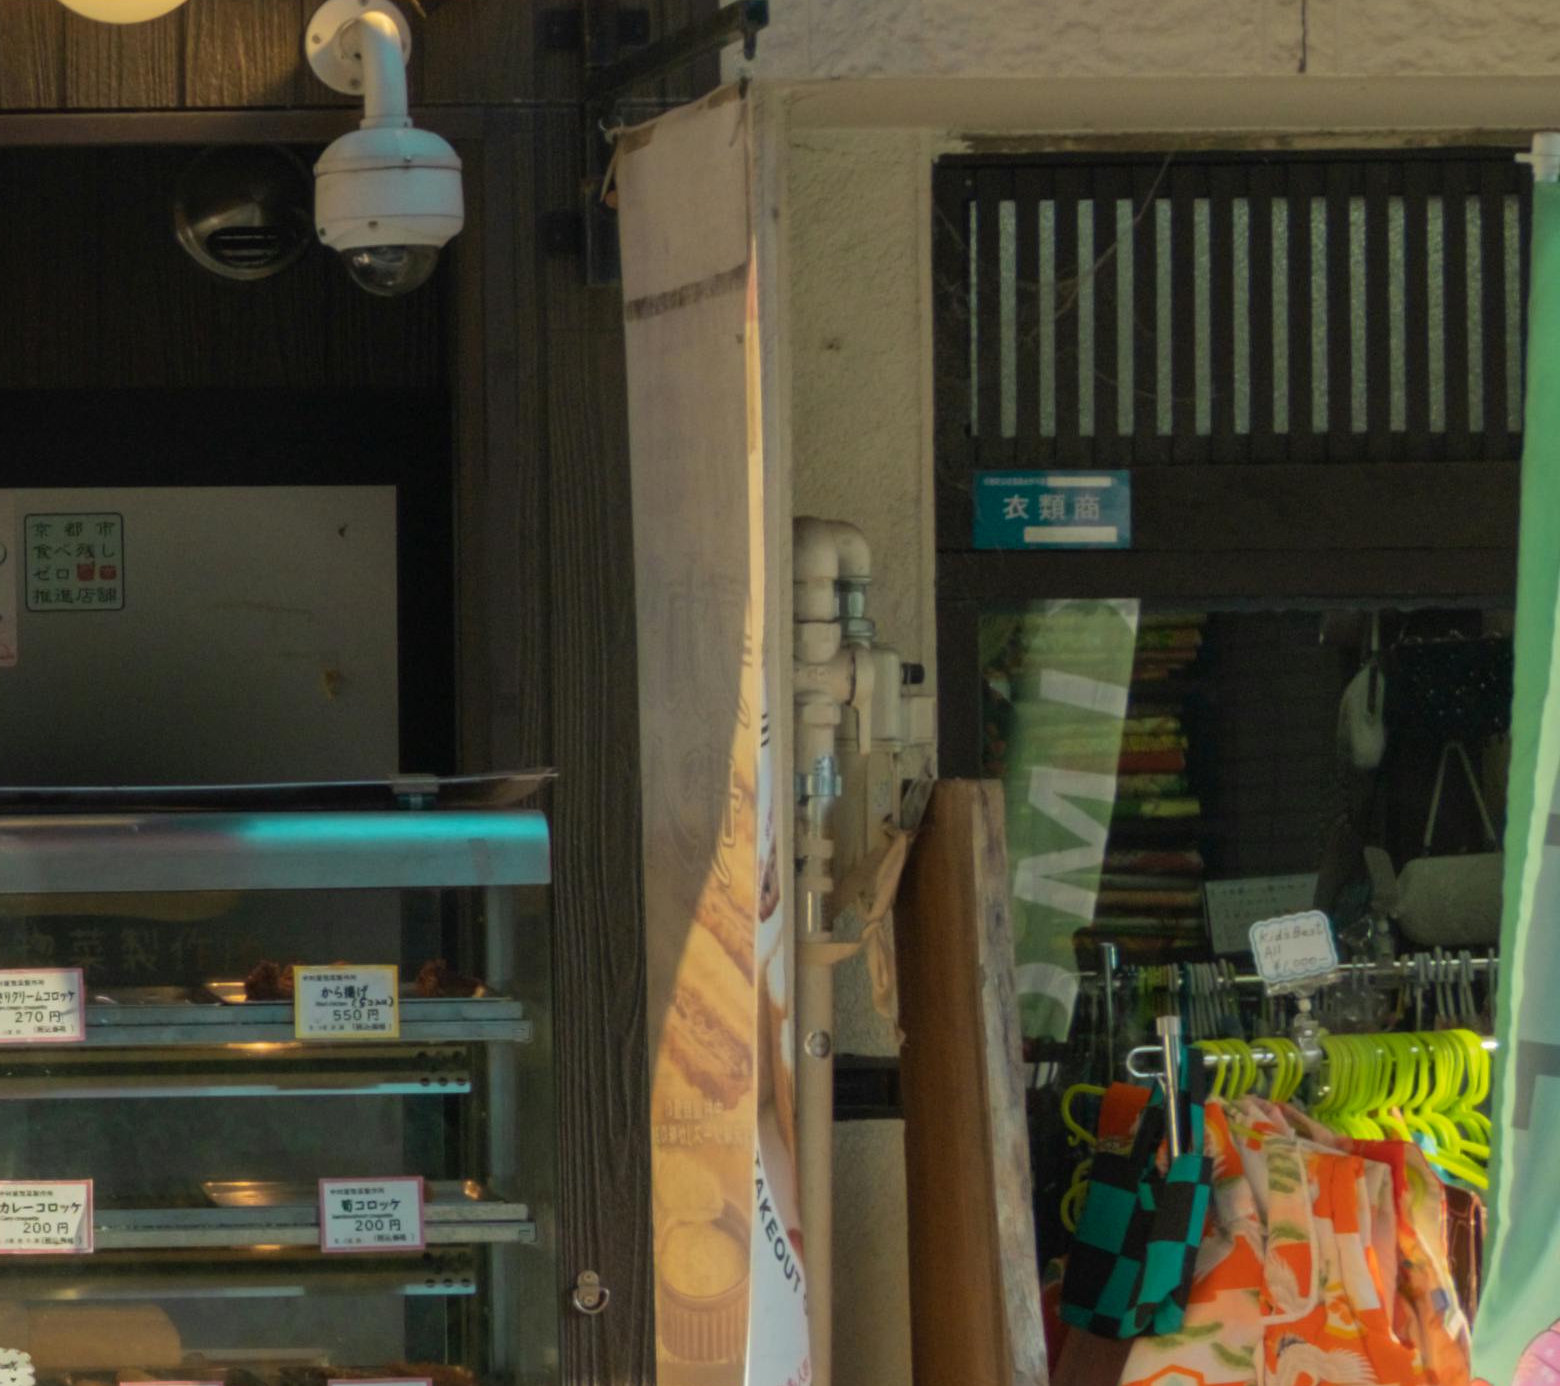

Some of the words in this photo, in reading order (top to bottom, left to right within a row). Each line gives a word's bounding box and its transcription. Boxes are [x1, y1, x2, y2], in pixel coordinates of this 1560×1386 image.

[1002, 493, 1102, 522] 衣類商
[32, 521, 116, 538] 京都市
[31, 541, 116, 559] 食べ残し
[31, 565, 71, 582] ゼロ
[31, 587, 118, 605] 推進店舗
[0, 1200, 84, 1215] カレーコロッケ
